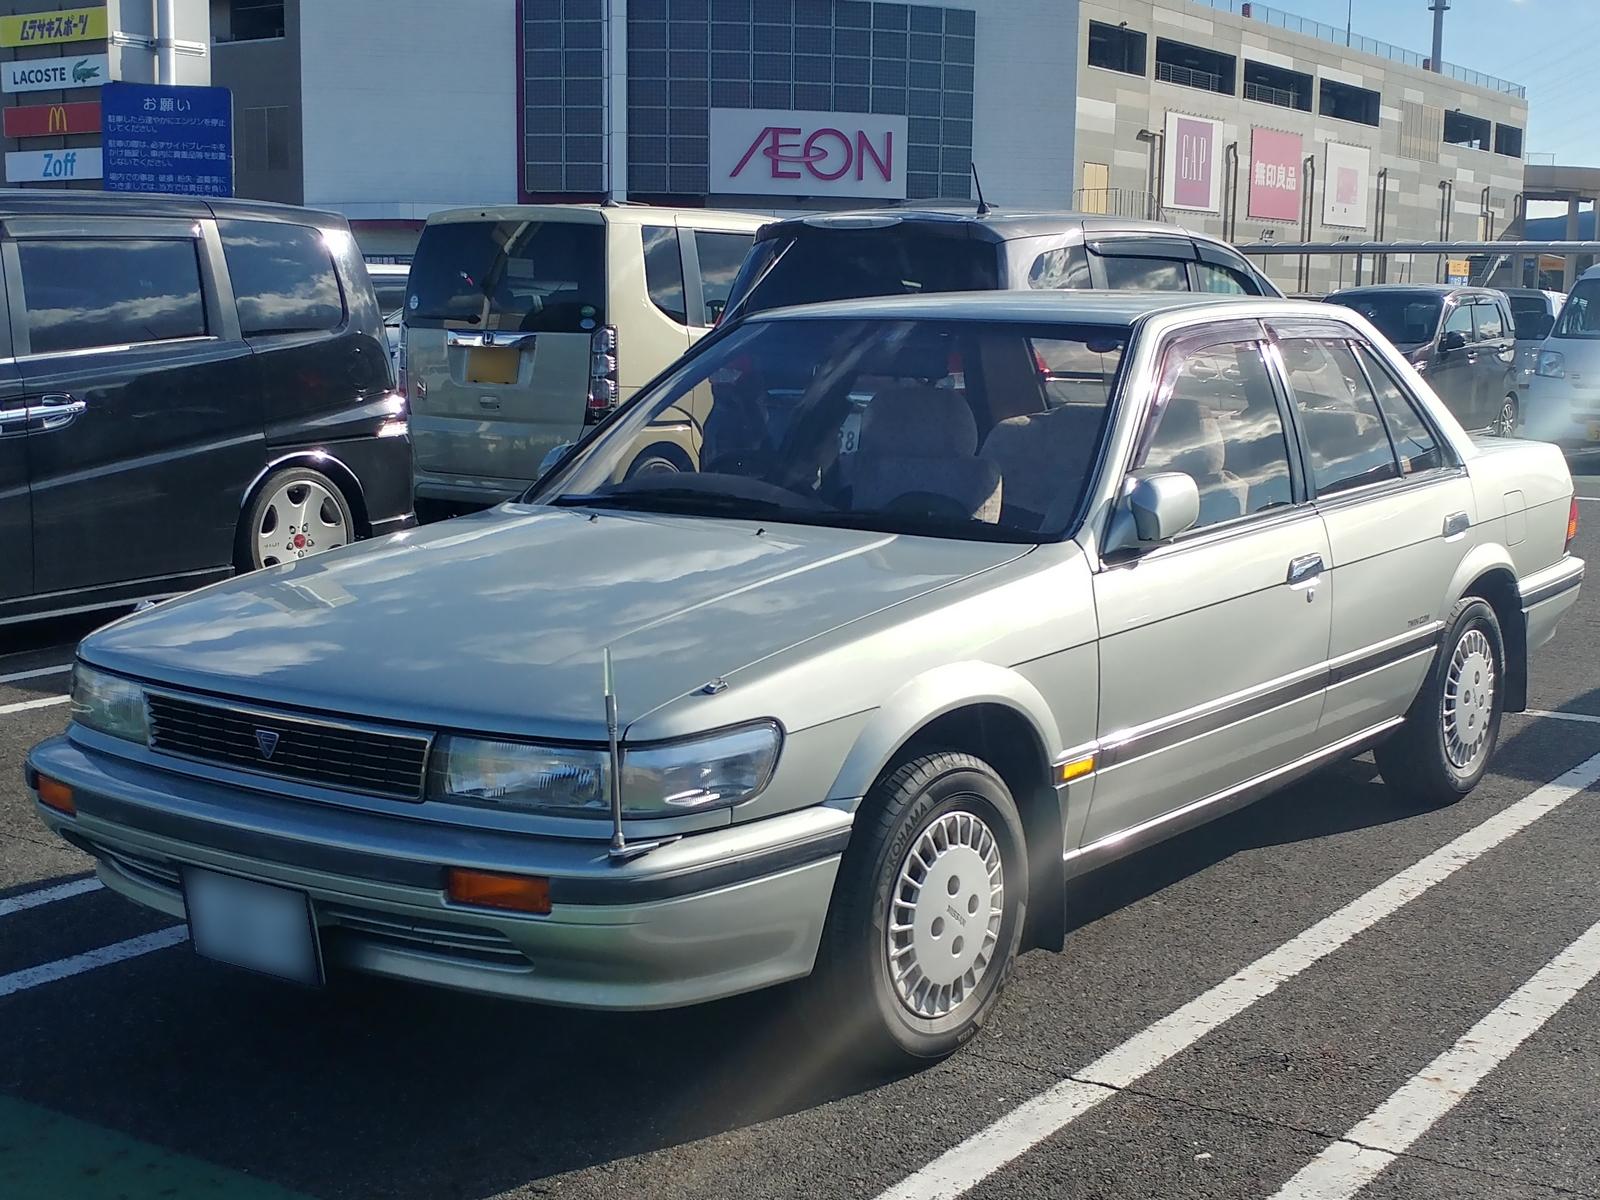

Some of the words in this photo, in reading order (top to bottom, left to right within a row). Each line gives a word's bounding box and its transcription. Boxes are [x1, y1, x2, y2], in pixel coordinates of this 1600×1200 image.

[20, 14, 88, 41] ムラサキスポーツ
[13, 67, 66, 85] LACOSTE
[143, 97, 191, 112] お願い
[43, 152, 76, 177] Zoff
[1181, 134, 1206, 181] GAP
[1255, 160, 1296, 191] 無印良品
